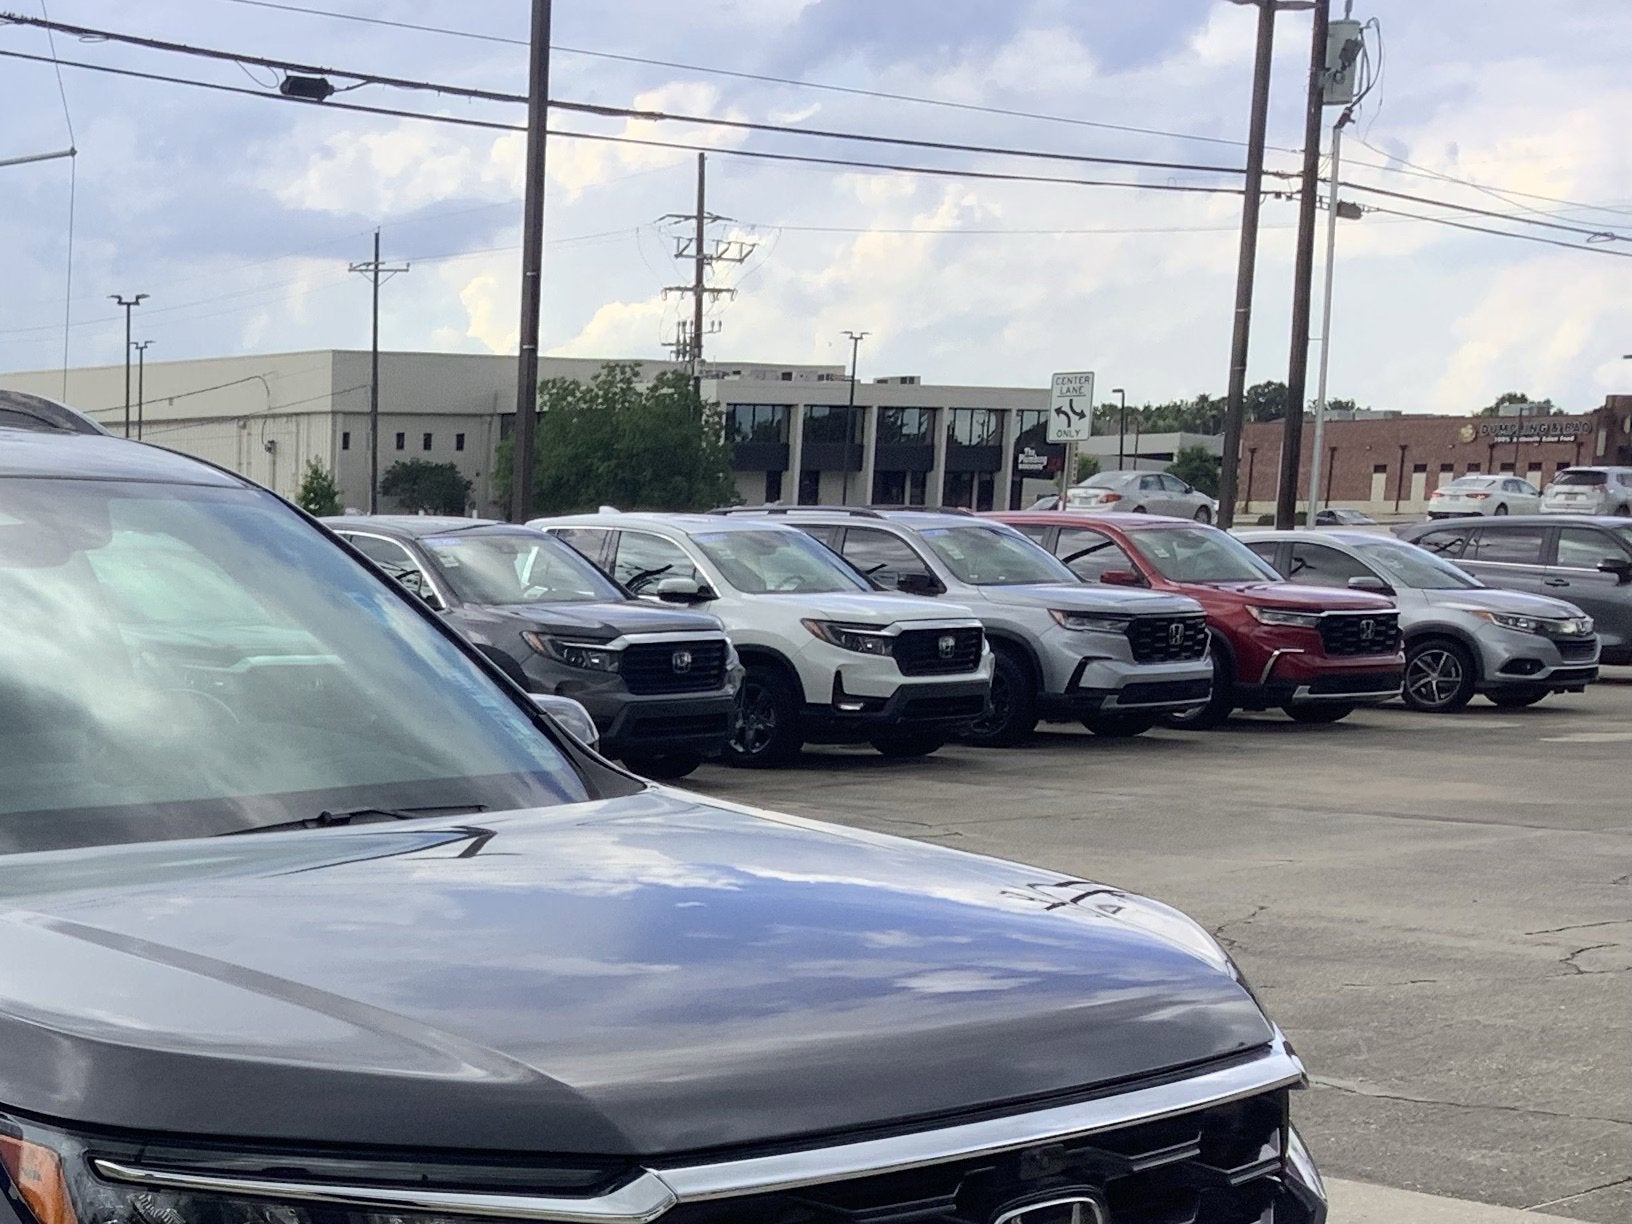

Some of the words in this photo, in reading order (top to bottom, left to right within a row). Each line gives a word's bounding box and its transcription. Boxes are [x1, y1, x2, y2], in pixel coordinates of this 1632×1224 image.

[1055, 375, 1090, 386] CENTER
[1059, 386, 1085, 395] LANE
[1056, 429, 1081, 438] ONLY
[1481, 422, 1548, 435] DUMPING
